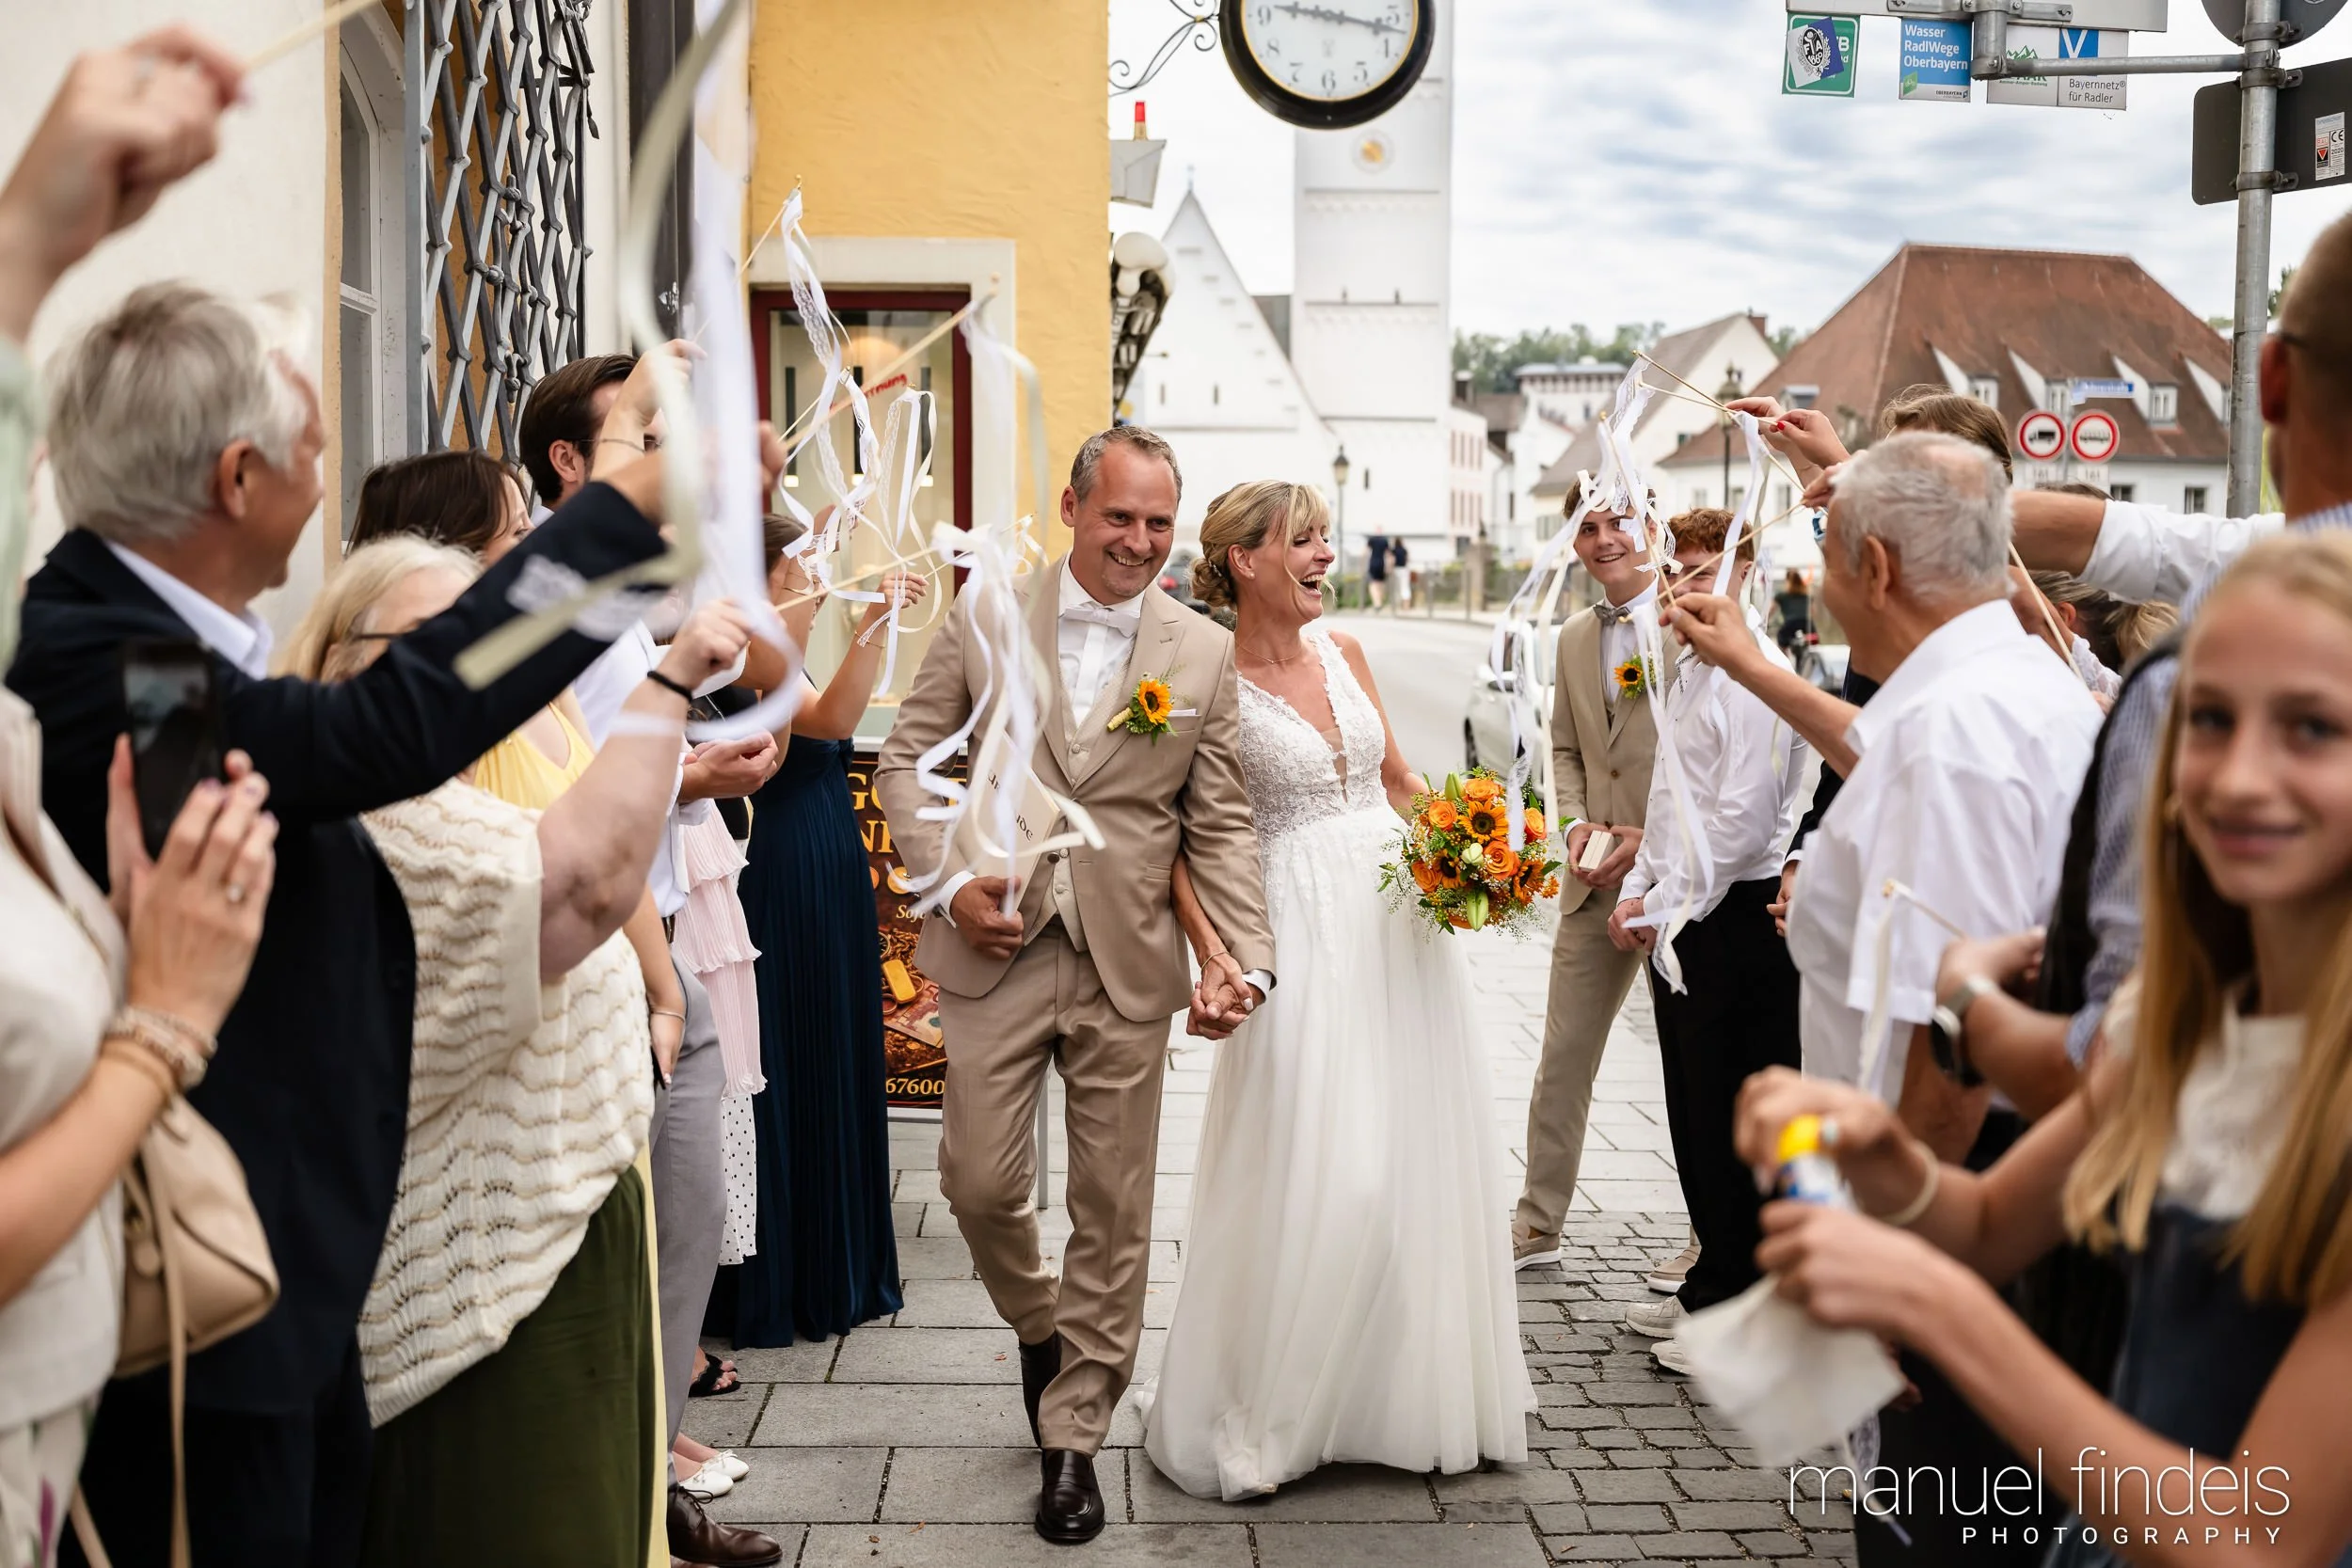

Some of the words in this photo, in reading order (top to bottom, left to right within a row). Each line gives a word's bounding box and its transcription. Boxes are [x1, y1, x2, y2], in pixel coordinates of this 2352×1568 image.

[1257, 6, 1271, 25] 9
[1904, 24, 1947, 38] Wasser
[1904, 40, 1960, 57] RadlWege
[1290, 62, 1303, 82] 7
[1903, 55, 1968, 72] Oberbayern
[1322, 70, 1336, 89] 6
[2069, 91, 2082, 103] für
[2084, 92, 2114, 103] Radler
[885, 1077, 946, 1095] 67600
